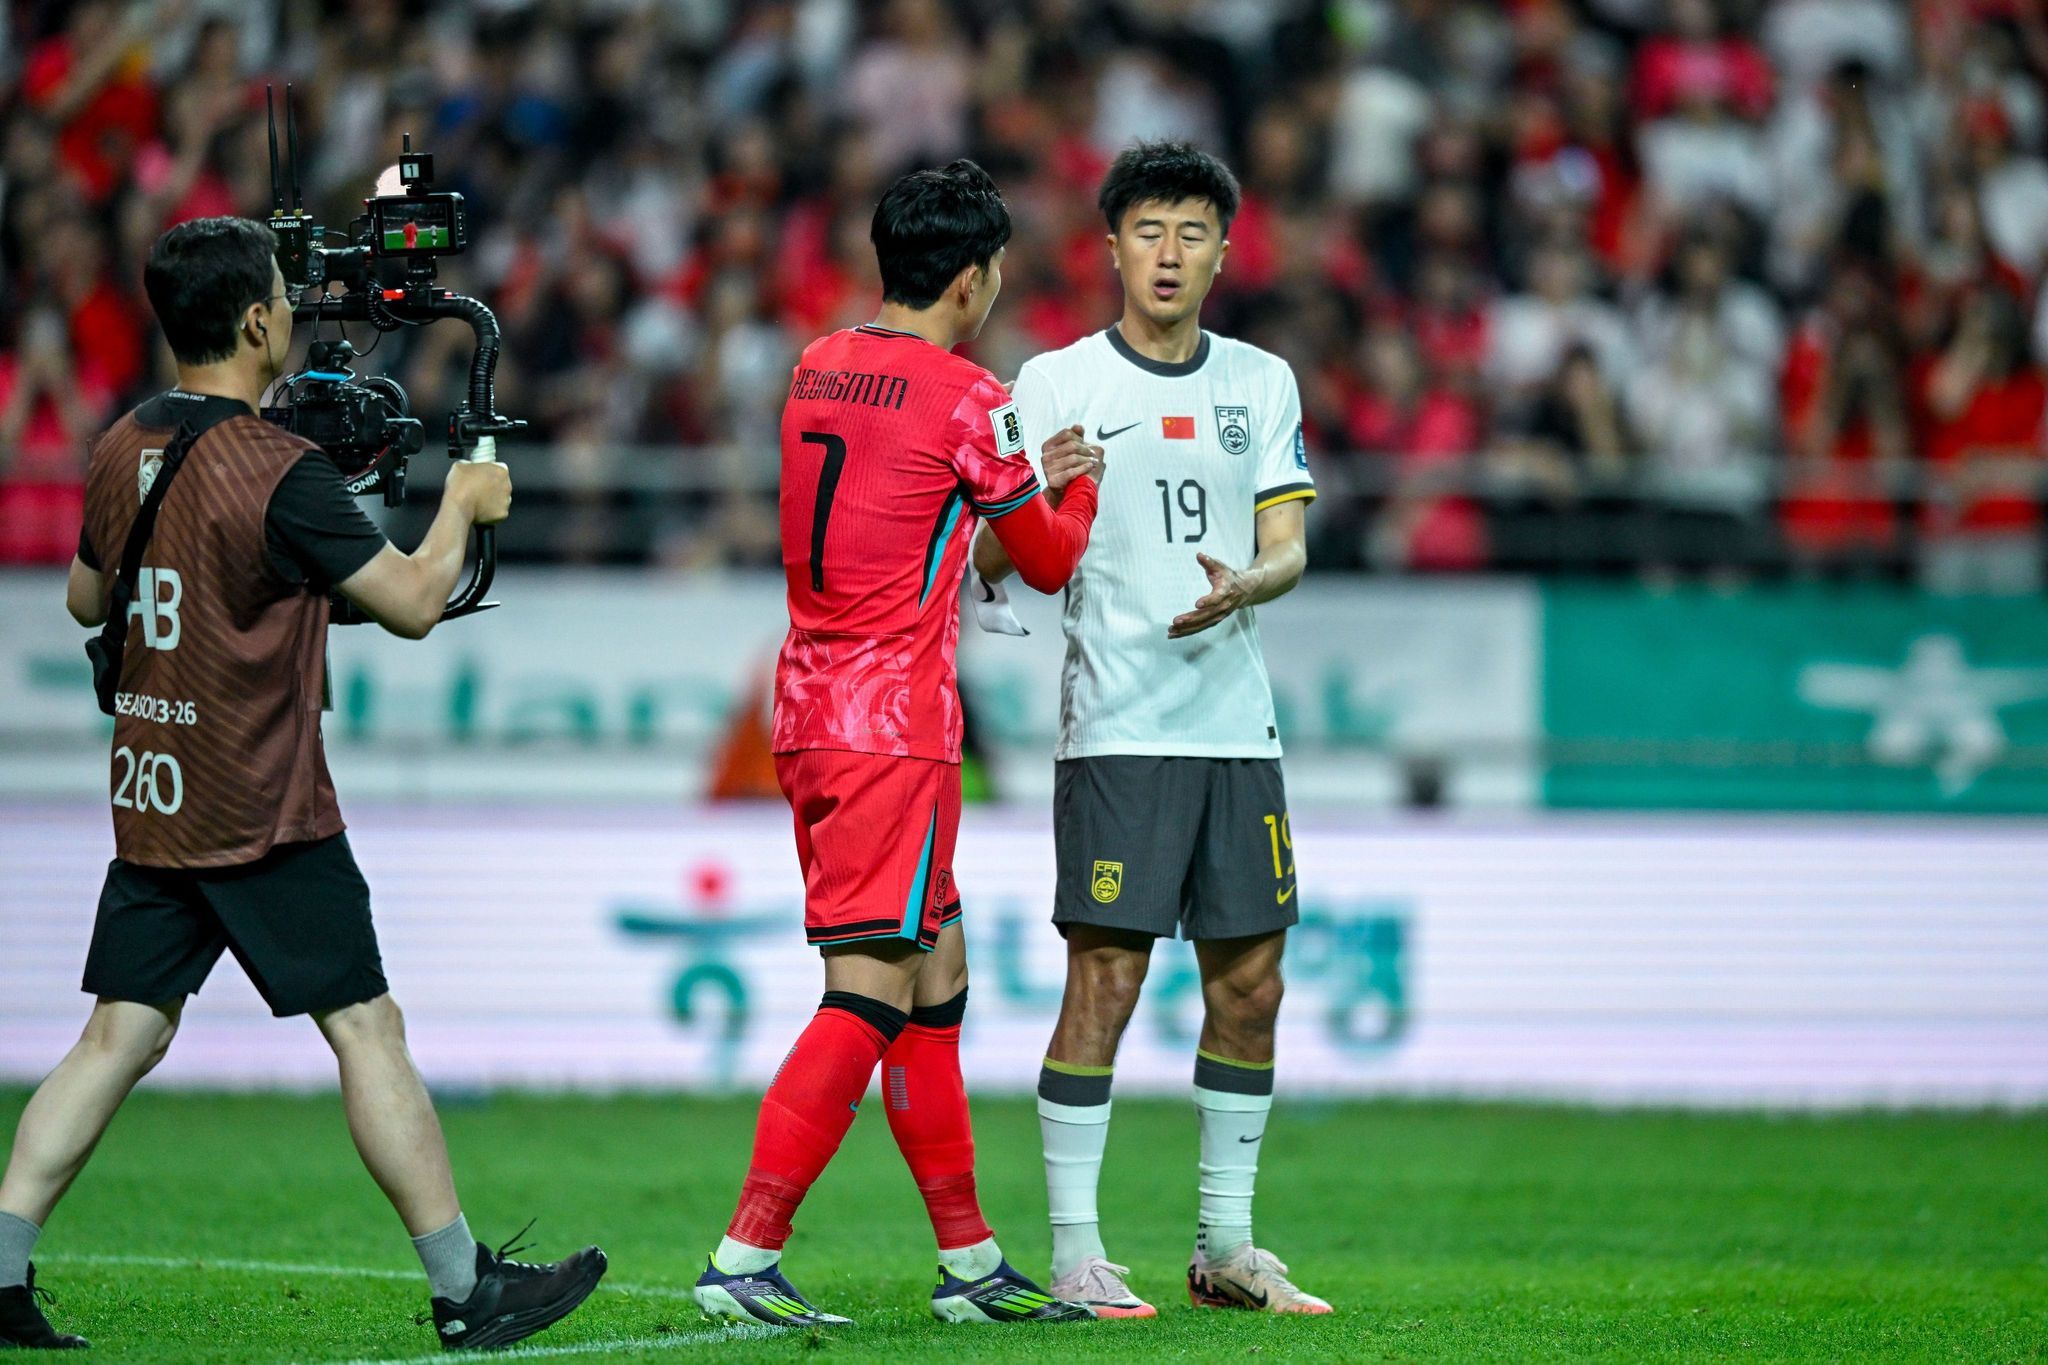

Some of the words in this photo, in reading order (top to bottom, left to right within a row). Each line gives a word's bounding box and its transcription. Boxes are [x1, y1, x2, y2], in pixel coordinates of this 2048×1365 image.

[270, 220, 302, 229] TERADEK
[1218, 409, 1246, 419] CFA
[346, 469, 381, 494] ONIN
[801, 431, 848, 593] 7
[1155, 478, 1208, 544] 19
[112, 745, 184, 816] 260
[1096, 863, 1120, 873] CFA
